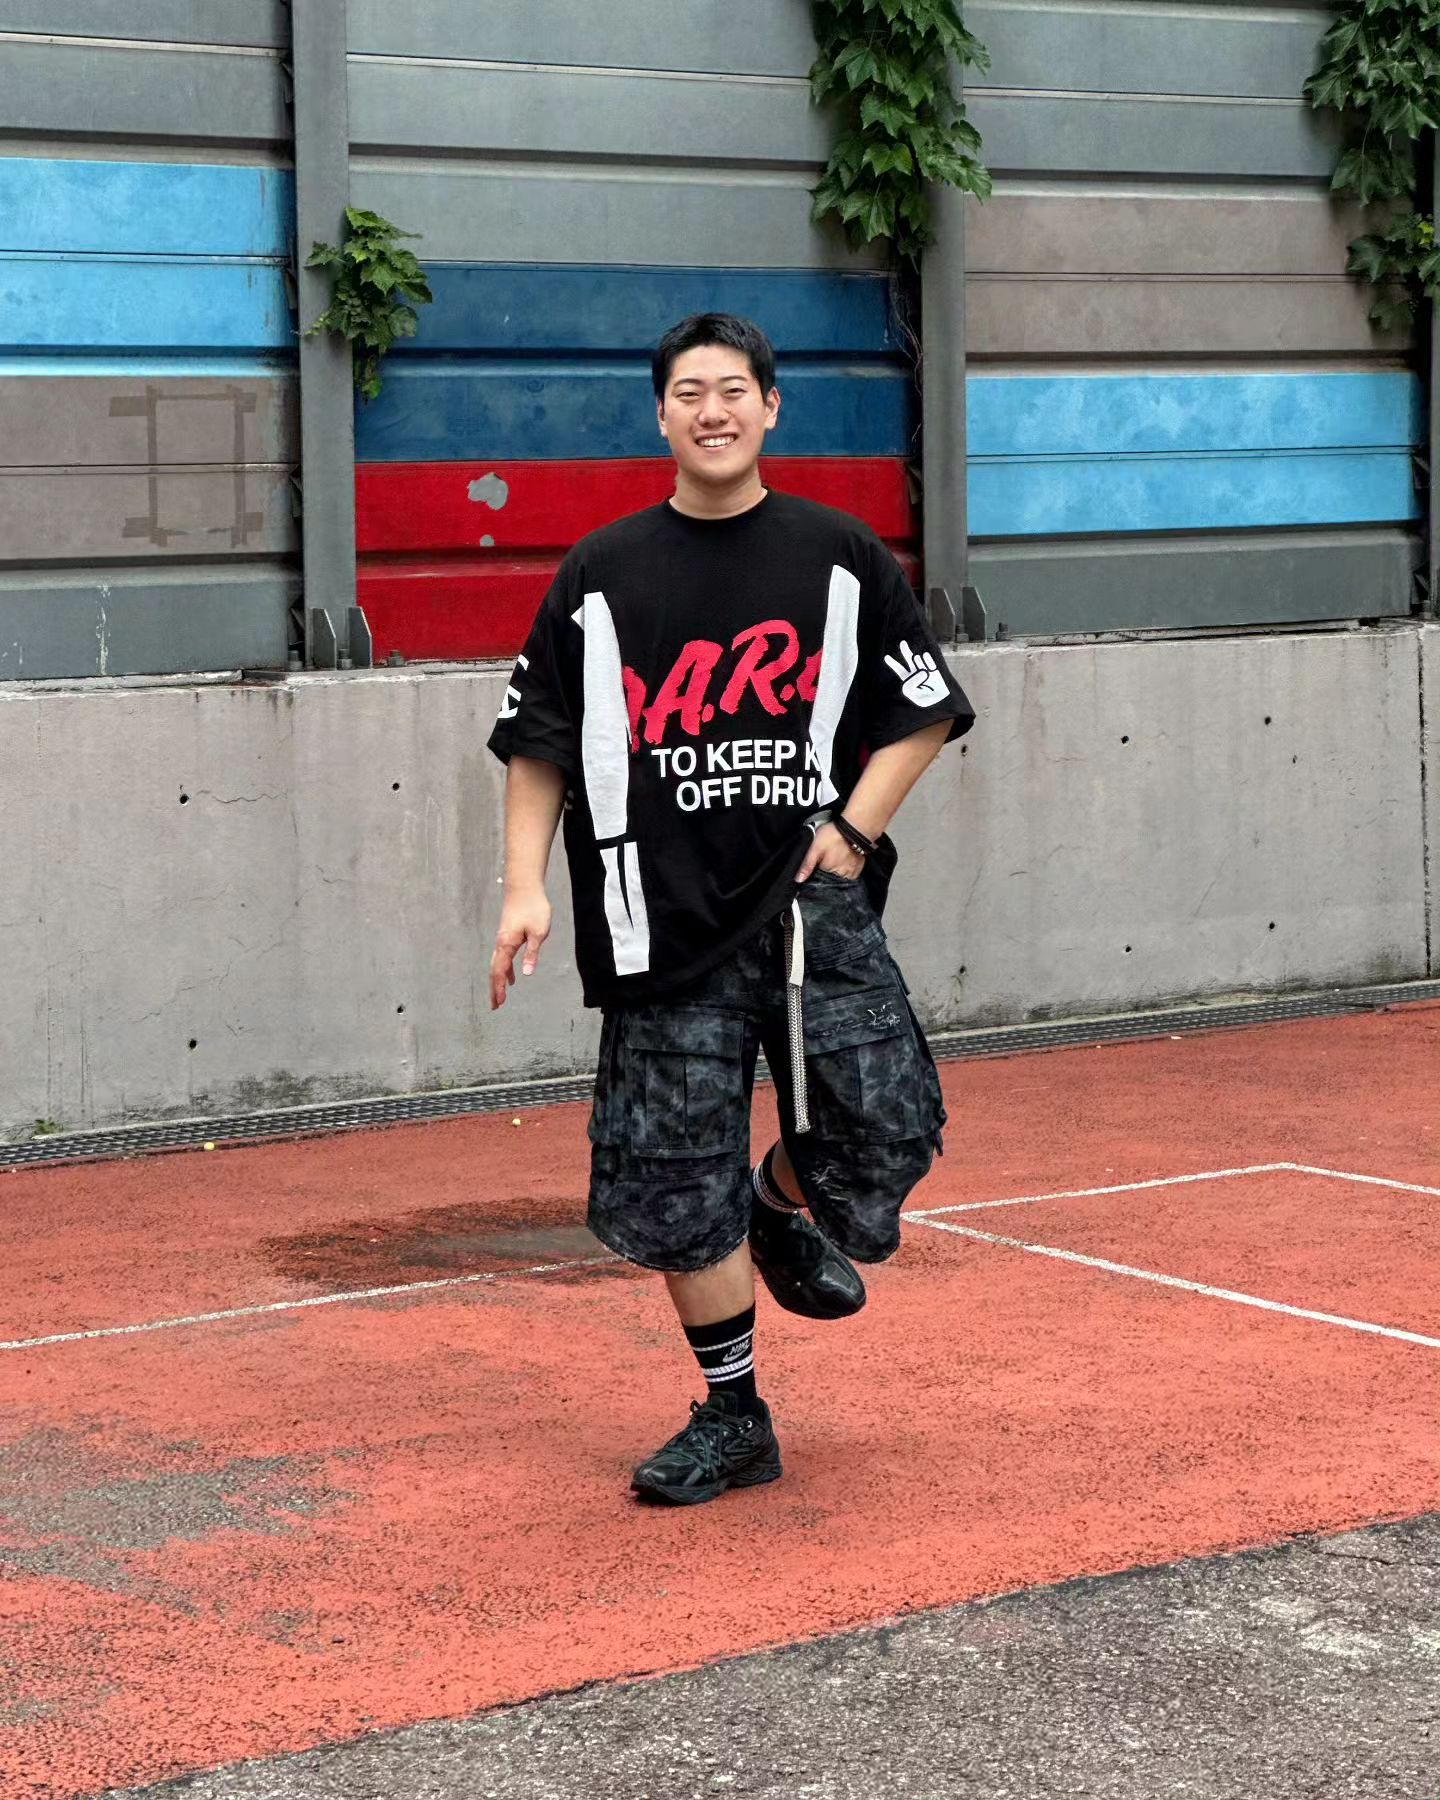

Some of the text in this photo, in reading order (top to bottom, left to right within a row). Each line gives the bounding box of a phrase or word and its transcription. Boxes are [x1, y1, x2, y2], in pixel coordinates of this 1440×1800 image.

[651, 746, 697, 777] TO
[707, 739, 797, 772] KEEP
[676, 776, 742, 811] OFF
